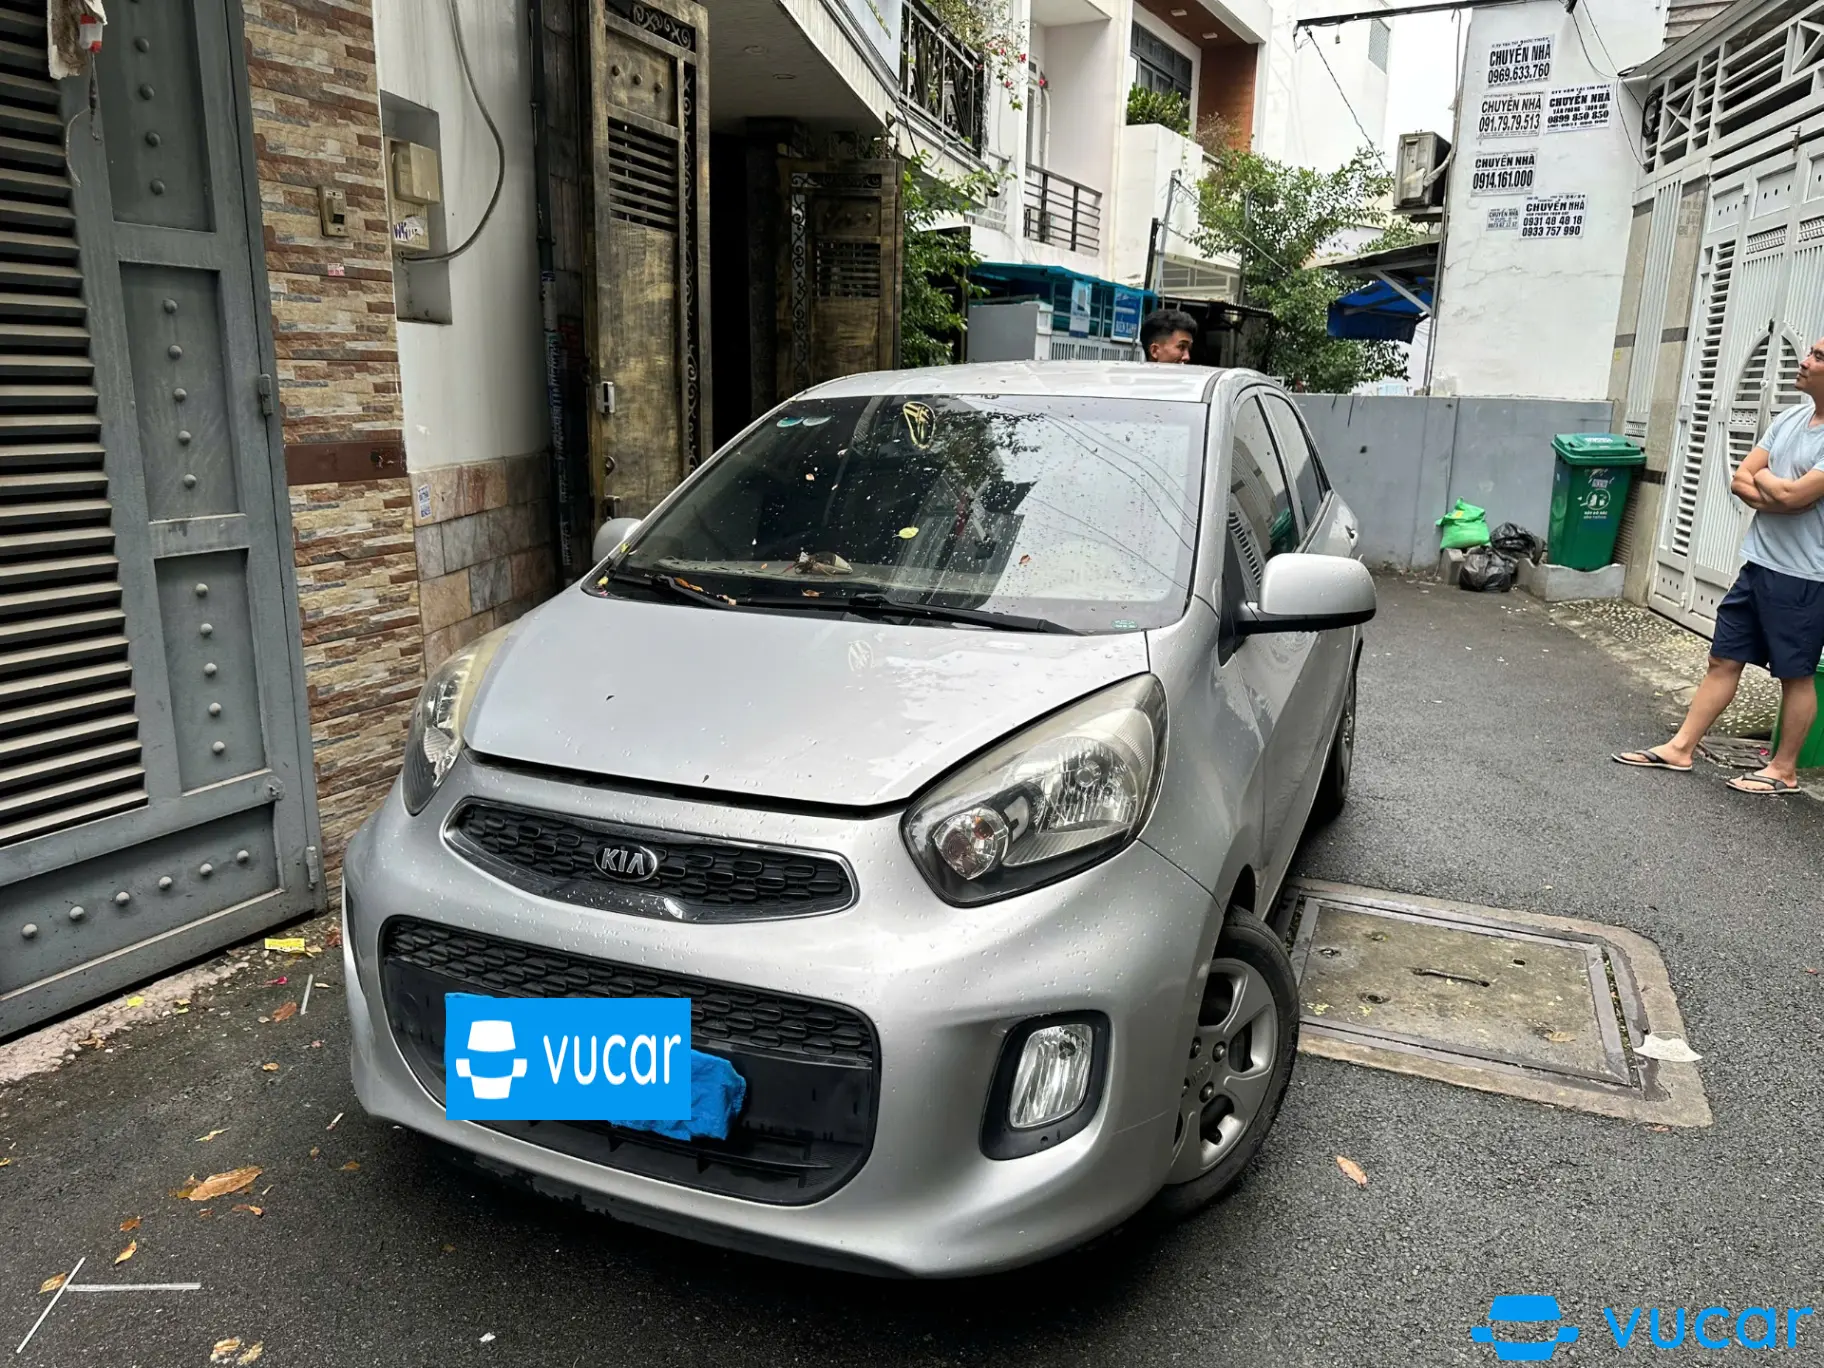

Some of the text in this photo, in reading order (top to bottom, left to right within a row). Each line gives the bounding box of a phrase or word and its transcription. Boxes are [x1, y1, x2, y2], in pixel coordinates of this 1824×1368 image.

[1490, 40, 1529, 66] CHUYỂN
[1531, 40, 1551, 61] NHÀ
[1488, 62, 1550, 83] 0969.633.760
[1482, 95, 1541, 113] CHUYỂN NHÀ
[1550, 90, 1610, 107] CHUYỂN NHÀ
[1479, 113, 1540, 132] 091.79.79.513
[1548, 110, 1609, 123] 0899 850 850
[1475, 154, 1534, 168] CHUYỂN NHÀ
[1473, 170, 1533, 189] 0914.161.000
[1526, 199, 1585, 212] CHUYỂN NHÀ
[1523, 217, 1543, 226] 0931
[1545, 217, 1556, 225] 48
[1559, 216, 1571, 225] 48
[1573, 216, 1583, 225] 18
[1522, 226, 1581, 236] 0933 757 990
[601, 847, 645, 875] KIA
